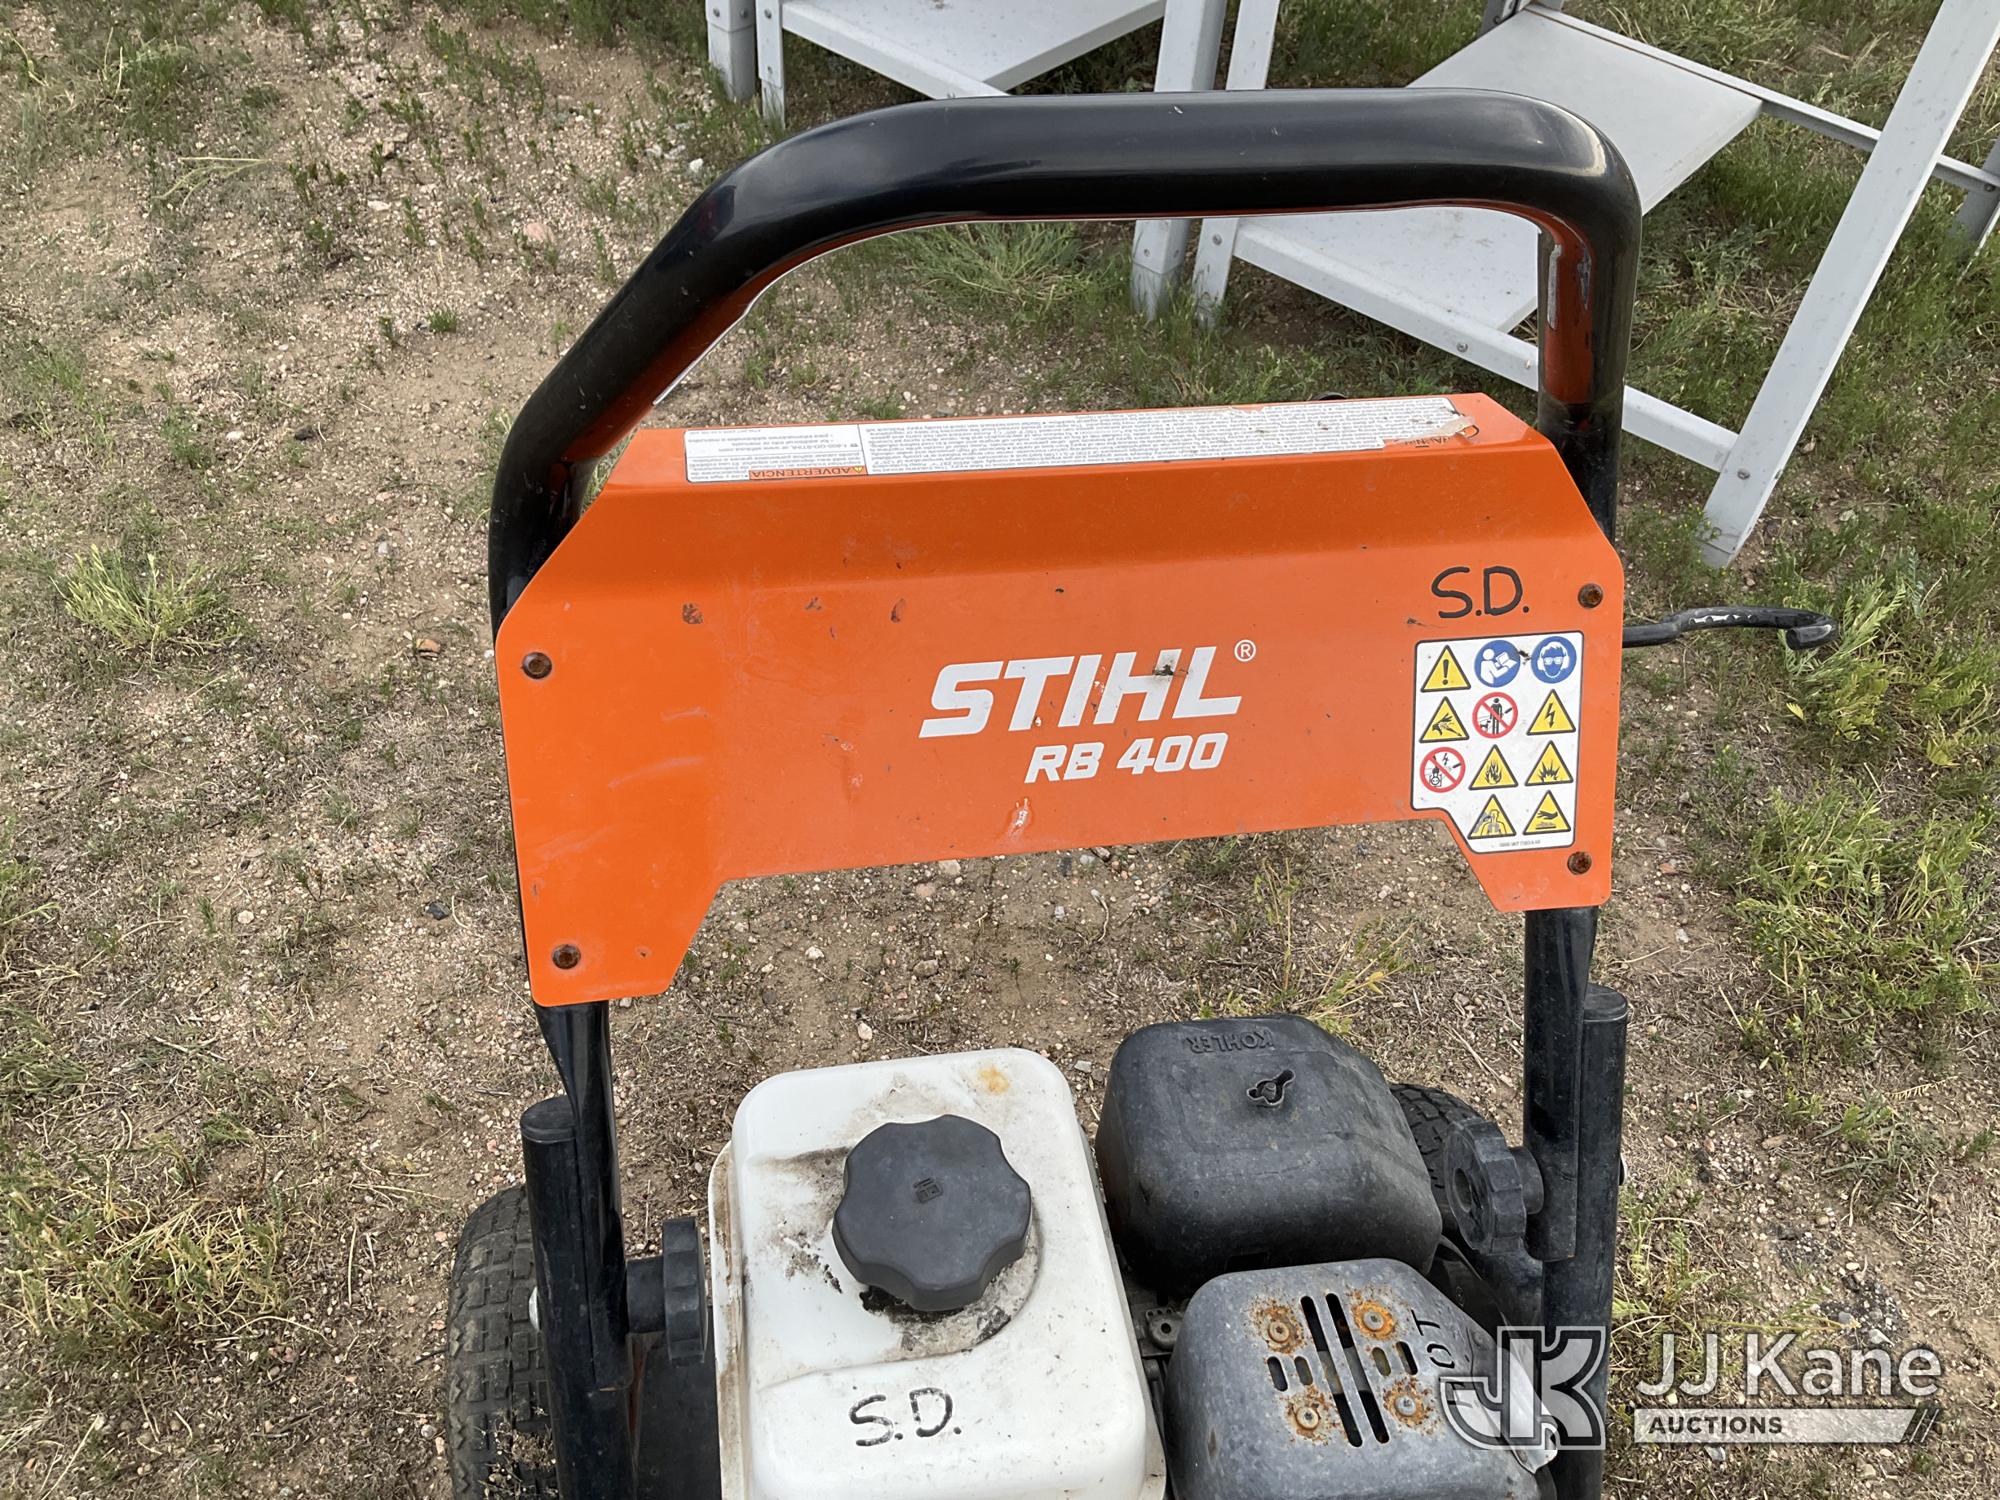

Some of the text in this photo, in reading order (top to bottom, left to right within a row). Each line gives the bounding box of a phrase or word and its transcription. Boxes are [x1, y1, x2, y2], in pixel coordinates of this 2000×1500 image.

[751, 466, 851, 479] ADVERTENCIA
[1431, 565, 1530, 619] S.D.
[918, 646, 1242, 738] STIHL
[1023, 732, 1229, 784] RB 400
[1185, 1027, 1275, 1054] KOHLER
[849, 1387, 962, 1447] S.D.
